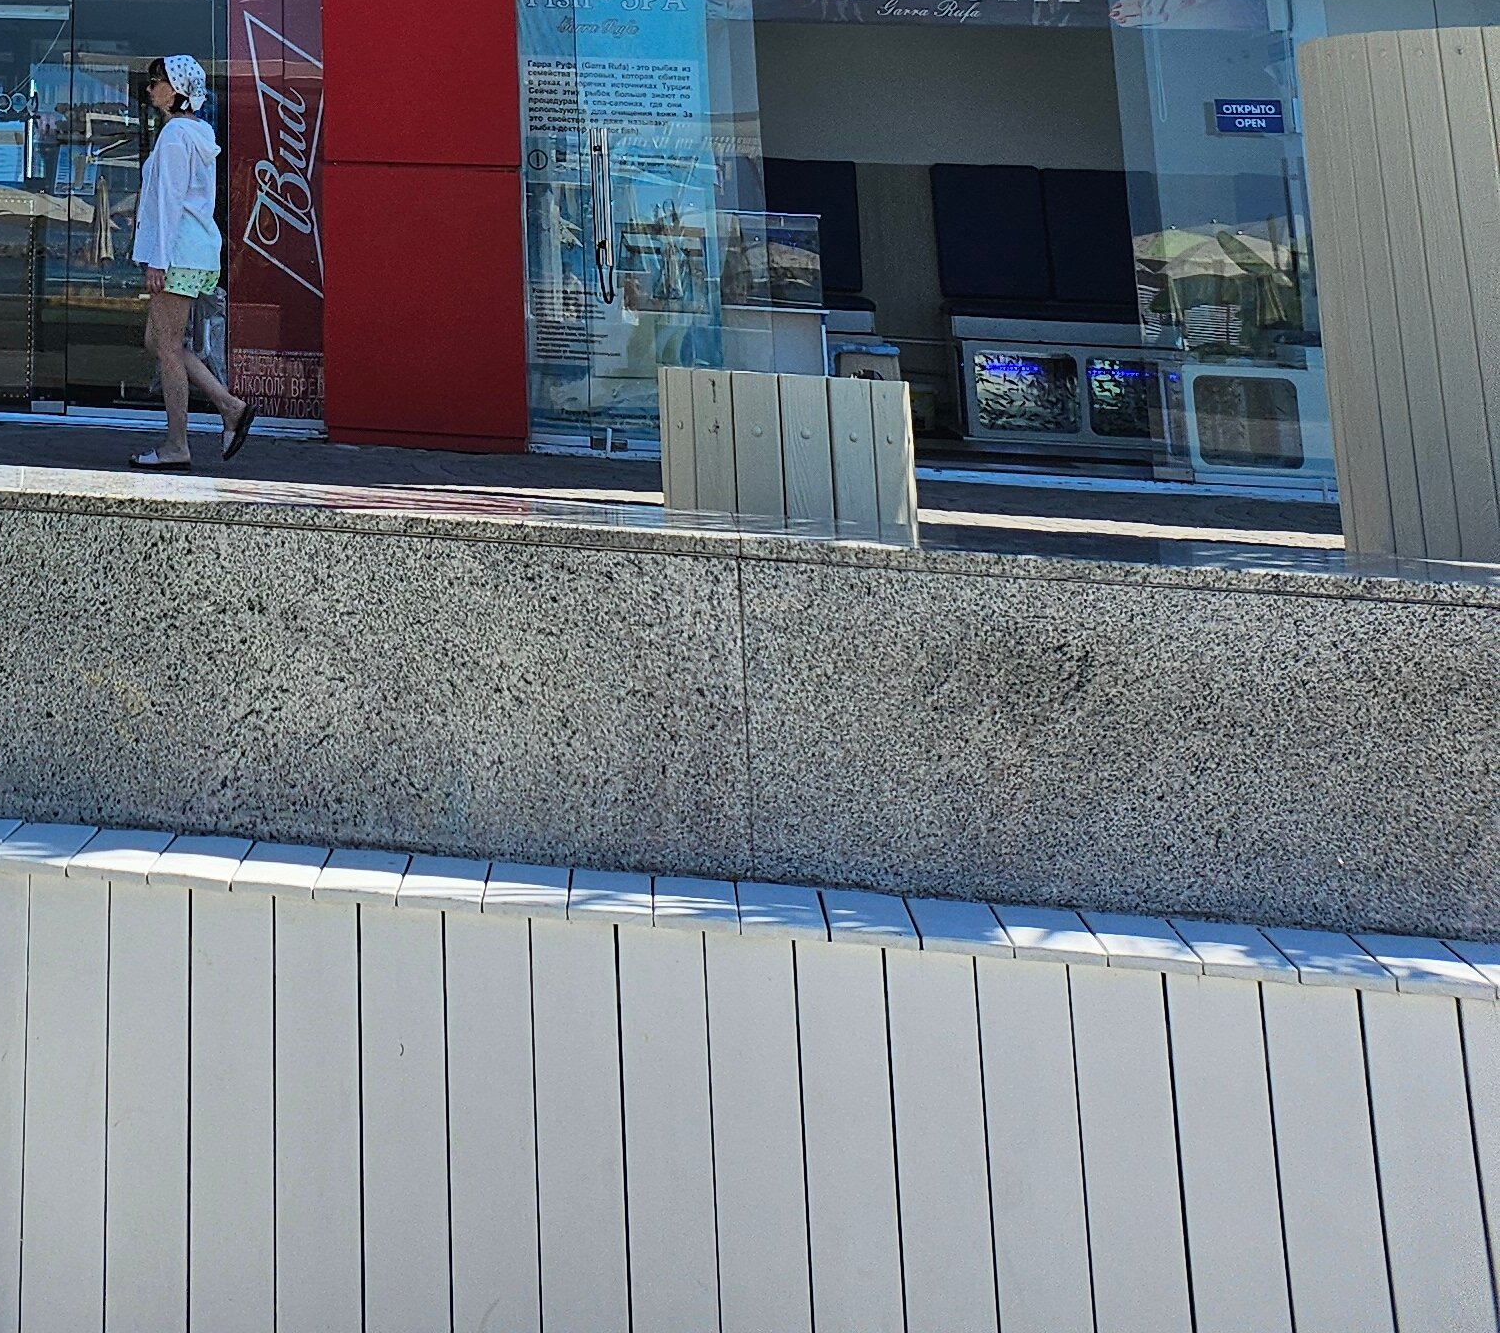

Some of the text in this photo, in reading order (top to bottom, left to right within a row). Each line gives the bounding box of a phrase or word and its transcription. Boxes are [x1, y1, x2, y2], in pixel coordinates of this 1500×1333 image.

[933, 0, 982, 23] Rufa
[528, 60, 552, 68] Гарра
[608, 62, 629, 72] Rufa)
[1222, 104, 1276, 114] ОТКРЫТО
[1235, 118, 1267, 128] OPEN
[255, 80, 312, 245] Bud
[283, 399, 324, 419] ЗДОРО
